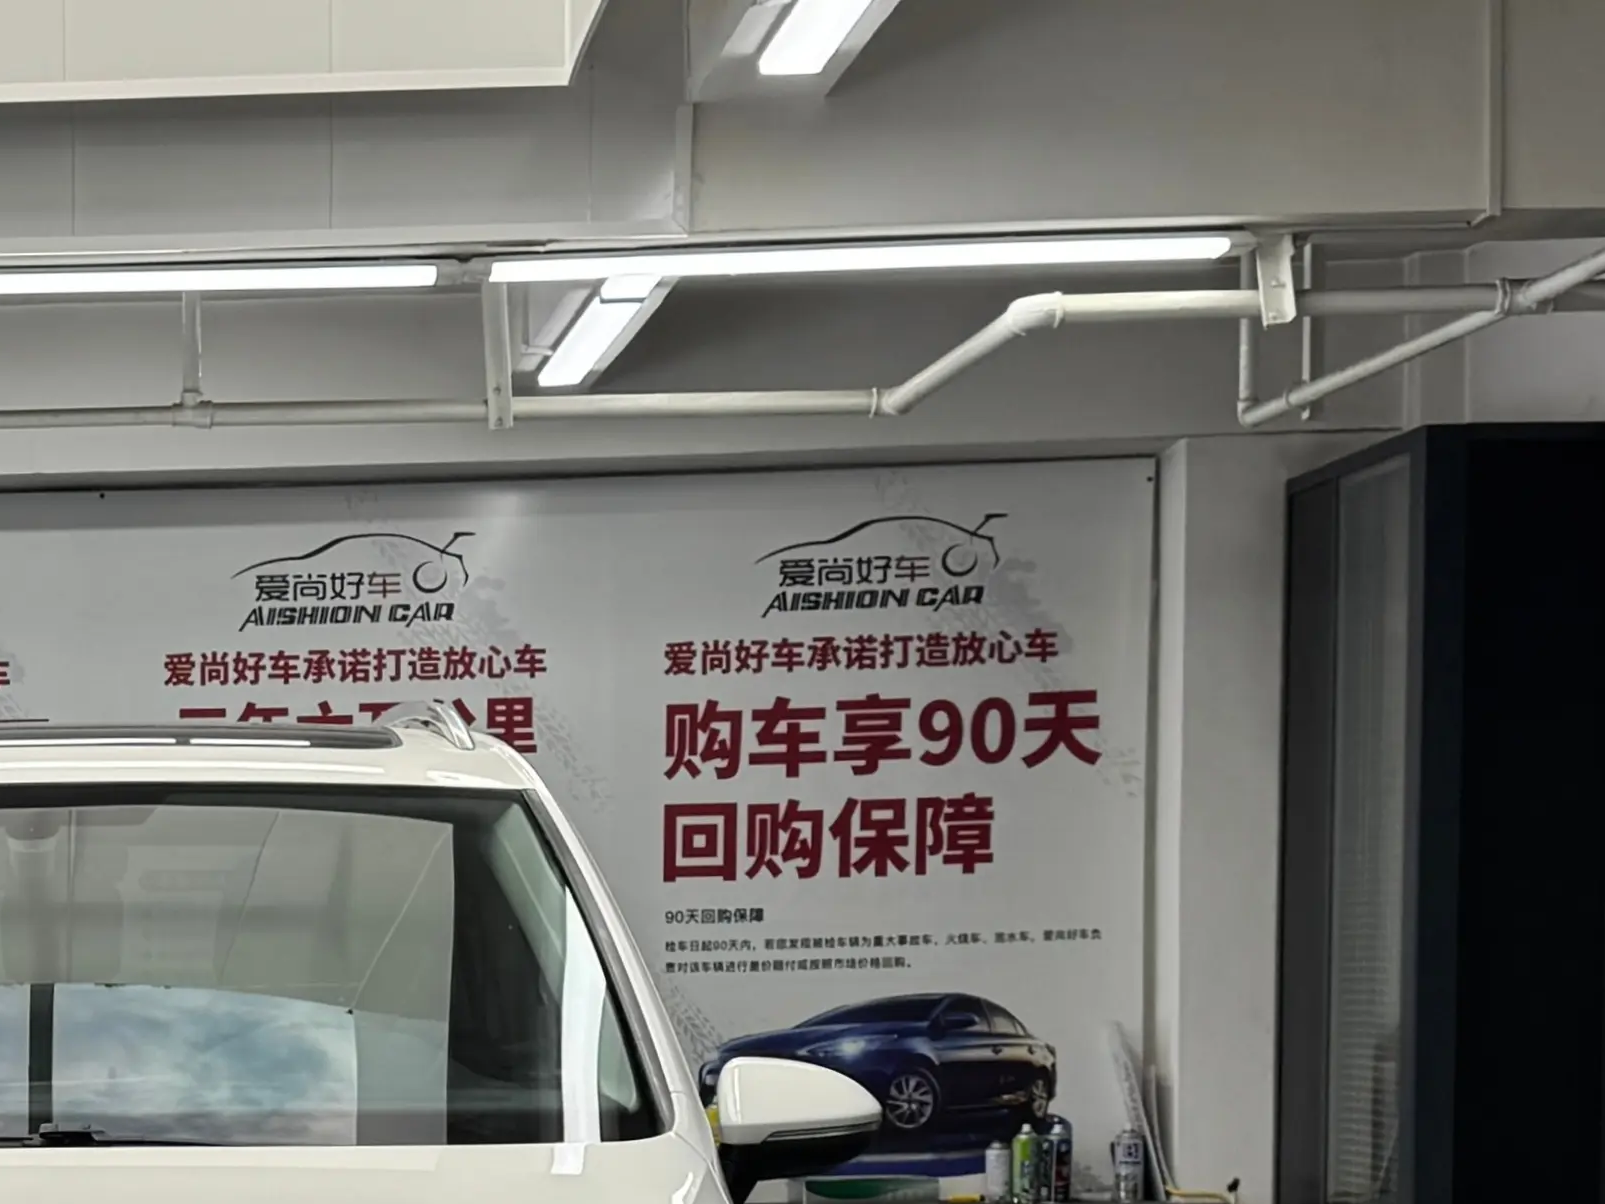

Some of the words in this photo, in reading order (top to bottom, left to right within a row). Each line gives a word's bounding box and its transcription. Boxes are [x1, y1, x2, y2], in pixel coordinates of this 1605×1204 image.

[255, 572, 402, 602] 爱尚好车
[778, 555, 931, 587] 爱尚好车
[238, 604, 382, 632] AISHION
[388, 602, 456, 628] CAR
[761, 587, 909, 618] AISHION
[915, 585, 985, 611] CAR
[163, 644, 548, 687] 爱尚好车承诺打造放心车
[663, 628, 1059, 676] 爱尚好车承诺打造放心车
[662, 689, 1103, 780] 购车享90天
[662, 792, 995, 883] 回购保障
[664, 907, 765, 925] 90天回购保障
